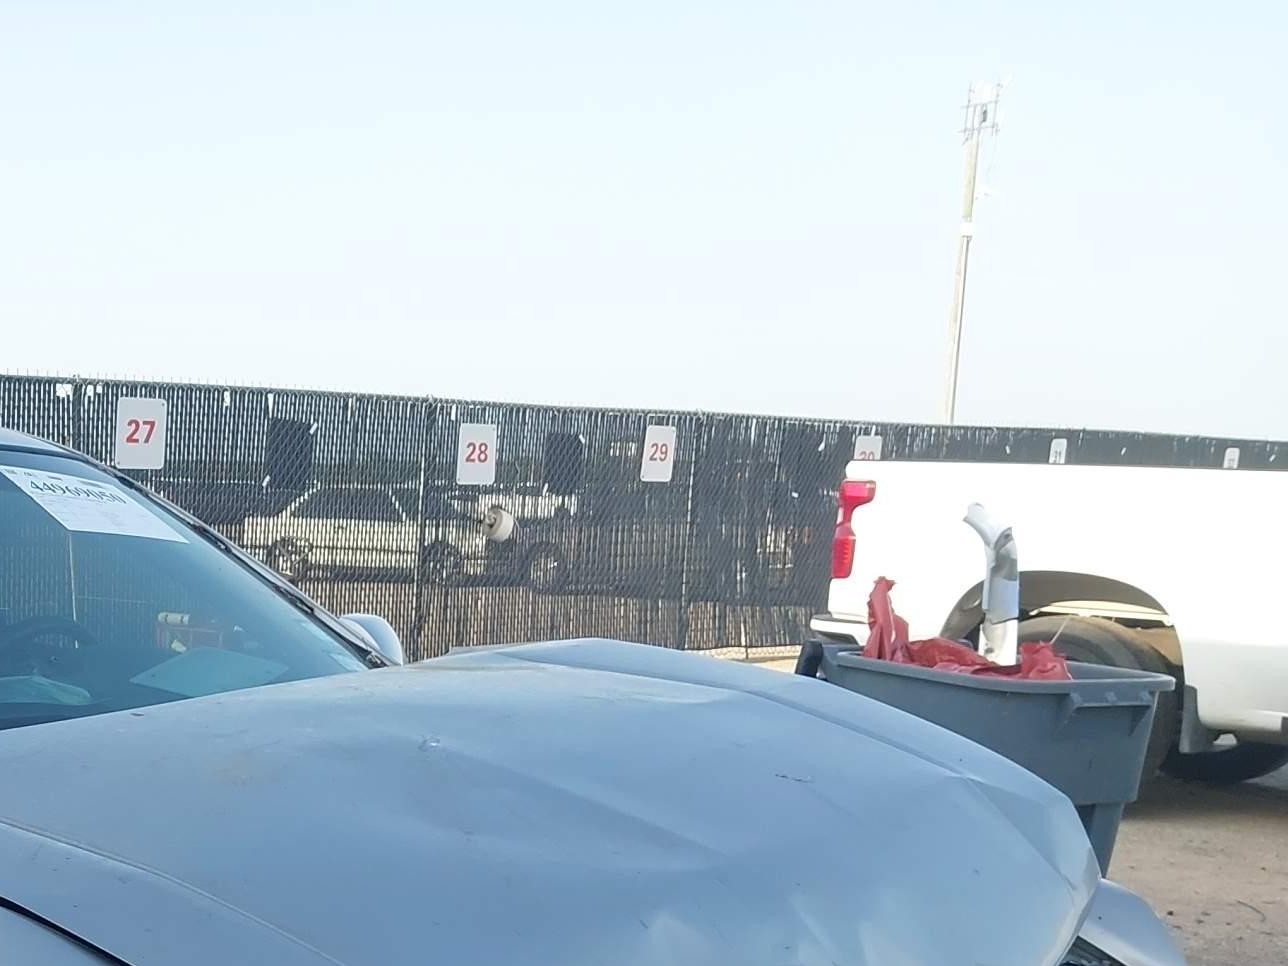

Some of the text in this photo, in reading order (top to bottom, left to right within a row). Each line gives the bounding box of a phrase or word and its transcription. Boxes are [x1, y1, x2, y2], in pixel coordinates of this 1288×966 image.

[125, 418, 156, 444] 27
[465, 442, 489, 463] 28
[649, 443, 668, 462] 29
